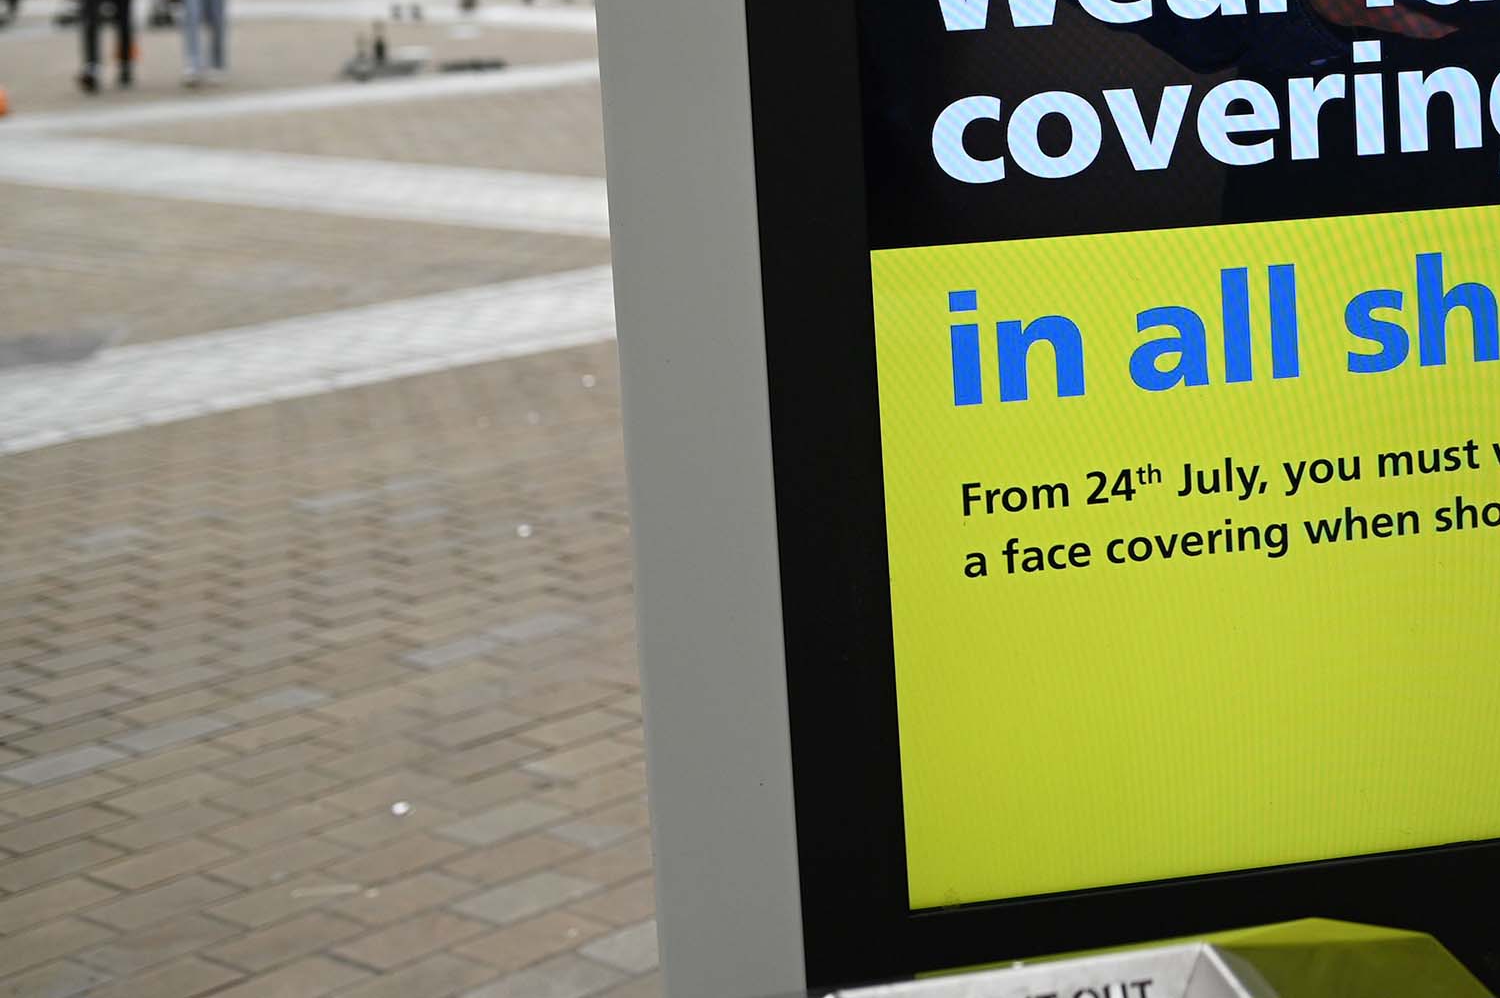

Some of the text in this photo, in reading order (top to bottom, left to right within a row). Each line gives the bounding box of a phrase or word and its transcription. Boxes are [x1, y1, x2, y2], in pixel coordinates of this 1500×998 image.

[949, 289, 1086, 406] in
[1129, 263, 1301, 392] all
[962, 482, 1070, 517] From
[1086, 467, 1163, 506] 24th
[1177, 457, 1269, 502] July,
[1282, 457, 1361, 497] you
[1378, 440, 1480, 479] must
[963, 552, 988, 579] a
[1001, 537, 1092, 575] face
[1106, 518, 1290, 560] covering
[1303, 506, 1420, 545] when
